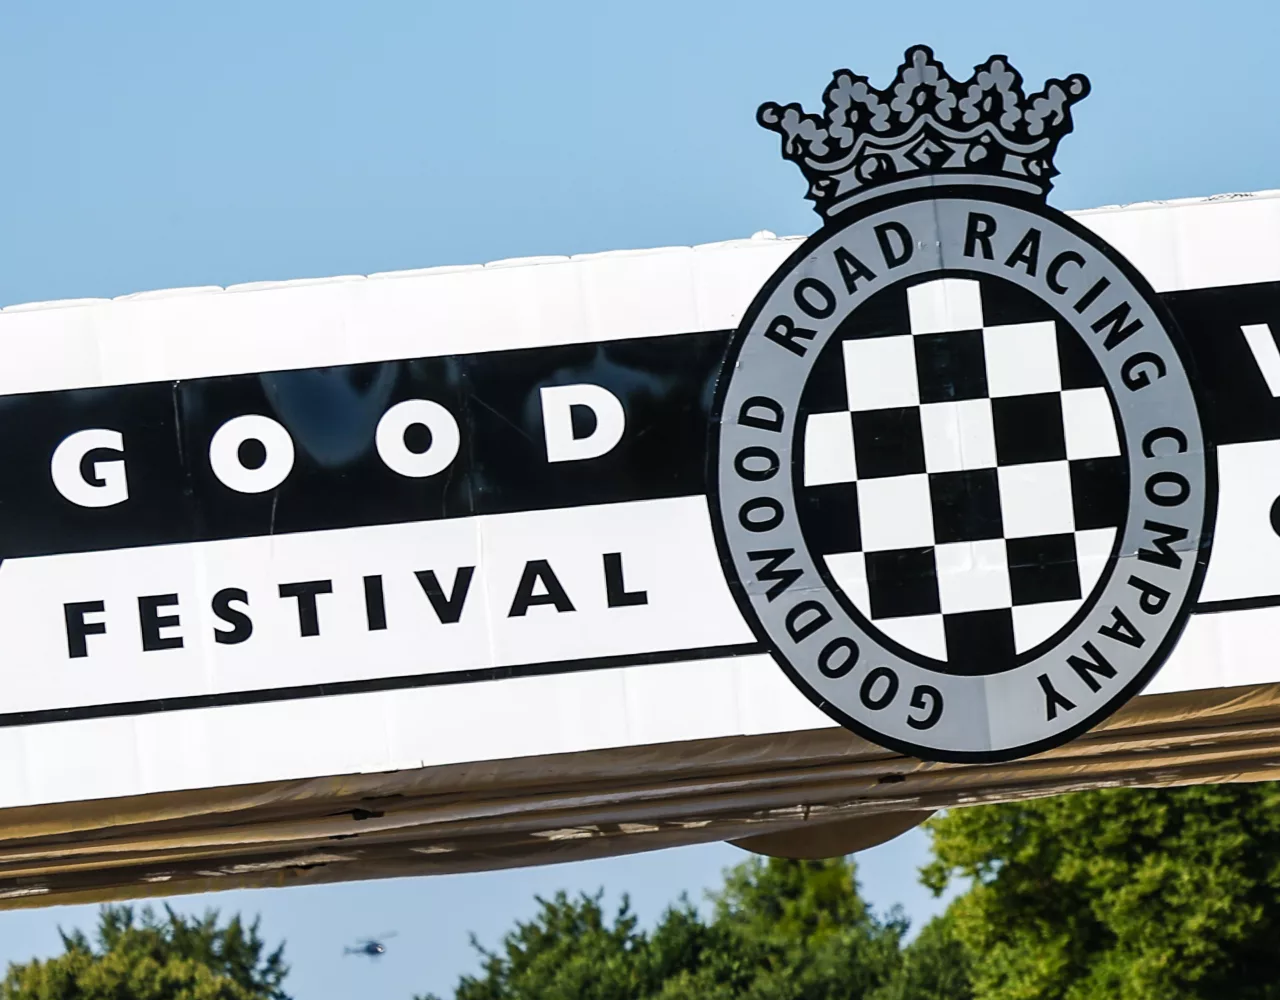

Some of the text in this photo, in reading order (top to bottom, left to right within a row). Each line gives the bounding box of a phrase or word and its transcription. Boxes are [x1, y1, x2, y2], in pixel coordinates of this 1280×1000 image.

[51, 383, 626, 508] GOOD
[764, 211, 1191, 722] ROAD RACING COMPANY
[63, 552, 649, 658] FESTIVAL
[733, 394, 945, 731] GOODWOOD
